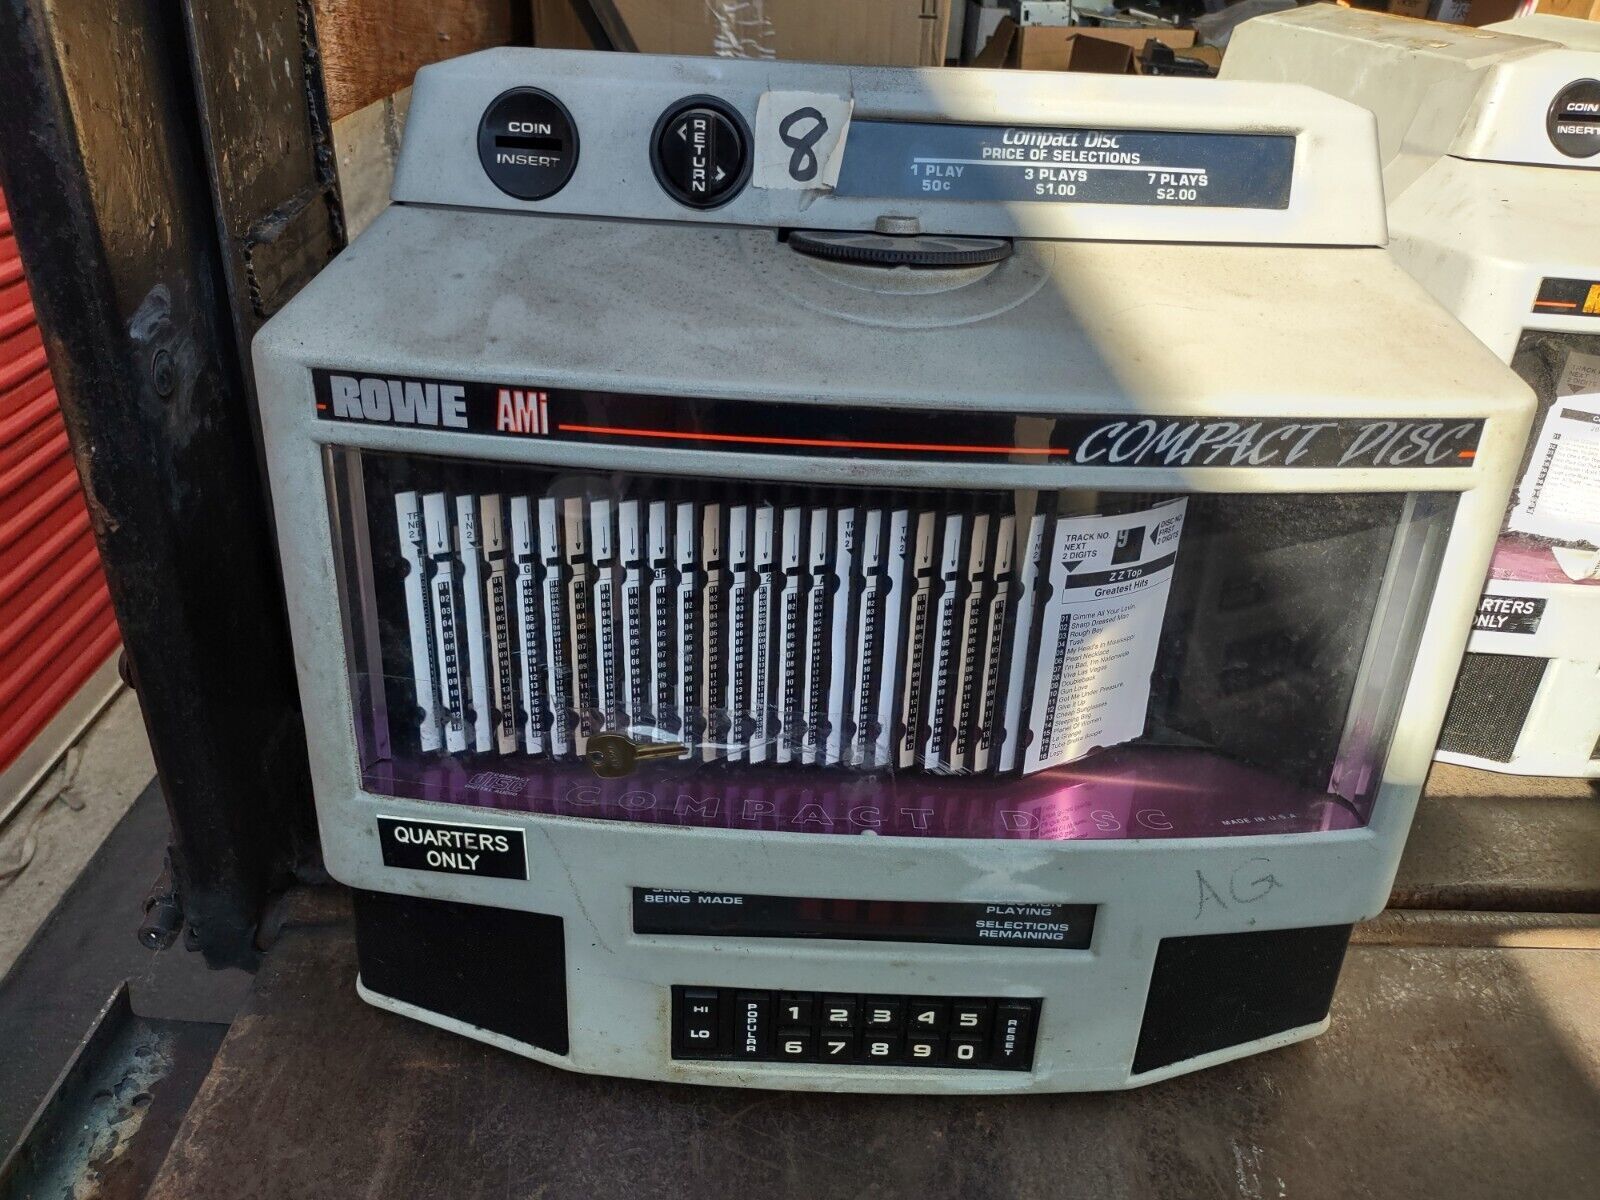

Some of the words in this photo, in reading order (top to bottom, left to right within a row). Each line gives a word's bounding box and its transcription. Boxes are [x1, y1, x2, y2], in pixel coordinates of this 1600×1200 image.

[1566, 102, 1599, 112] COIN
[507, 121, 552, 135] COIN
[1557, 125, 1600, 135] INSERT
[778, 106, 829, 182] 8
[1002, 129, 1078, 149] Compact
[1084, 132, 1122, 149] Disc
[496, 153, 561, 167] INSERT
[692, 119, 706, 192] RETURN
[982, 147, 1025, 160] PRICE
[1029, 149, 1048, 161] OF
[1053, 150, 1140, 165] SELECTIONS
[910, 164, 918, 176] 1
[925, 164, 964, 178] PLAY
[1024, 168, 1034, 180] 3
[1039, 169, 1088, 182] PLAYS
[1147, 173, 1156, 185] 7
[1160, 173, 1208, 186] PLAYS
[329, 374, 469, 430] ROWE
[1075, 419, 1339, 467] COMPACT
[1337, 420, 1476, 467] DISC
[1160, 517, 1175, 528] DISC
[1066, 533, 1095, 542] TRACK
[1096, 531, 1111, 540] NO.
[1158, 525, 1175, 536] FIRST
[1161, 531, 1179, 544] DIGITS
[1063, 542, 1087, 551] NEXT
[1069, 550, 1098, 559] DIGITS
[1109, 572, 1116, 582] Z
[1118, 571, 1125, 581] Z
[1127, 568, 1142, 580] Top
[438, 582, 449, 590] 01
[1094, 583, 1132, 598] Greatest
[1134, 579, 1149, 589] Hits
[439, 595, 450, 603] 02
[441, 606, 452, 614] 03
[1479, 598, 1535, 614] RTERS
[443, 619, 452, 627] 04
[1072, 613, 1096, 621] Gimme
[1070, 630, 1091, 638] Rough
[1091, 627, 1104, 635] Boy
[1071, 622, 1090, 630] Sharp
[1066, 647, 1077, 655] My
[447, 666, 457, 674] 08
[565, 785, 935, 830] COMPACT
[1000, 809, 1173, 832] DSC
[1222, 816, 1250, 826] MADE
[1253, 815, 1264, 823] IN
[394, 826, 509, 853] QUARTERS
[426, 850, 480, 871] ONLY
[644, 894, 693, 904] BEING
[698, 895, 744, 905] MADE
[986, 906, 1052, 917] PLAYING
[975, 920, 1070, 932] SELECTIONS
[978, 929, 1065, 941] REMAINING
[693, 1005, 709, 1014] HI
[788, 1006, 799, 1020] 1
[829, 1008, 848, 1022] 2
[873, 1009, 891, 1023] 3
[917, 1011, 935, 1024] 4
[959, 1013, 978, 1027] 5
[690, 1029, 710, 1038] LO
[746, 1003, 758, 1052] POPULAR
[1004, 1019, 1017, 1056] RESET
[785, 1041, 802, 1054] 6
[828, 1041, 846, 1054] 7
[871, 1042, 889, 1056] 8
[913, 1044, 931, 1057] 9
[957, 1045, 973, 1060] 0
